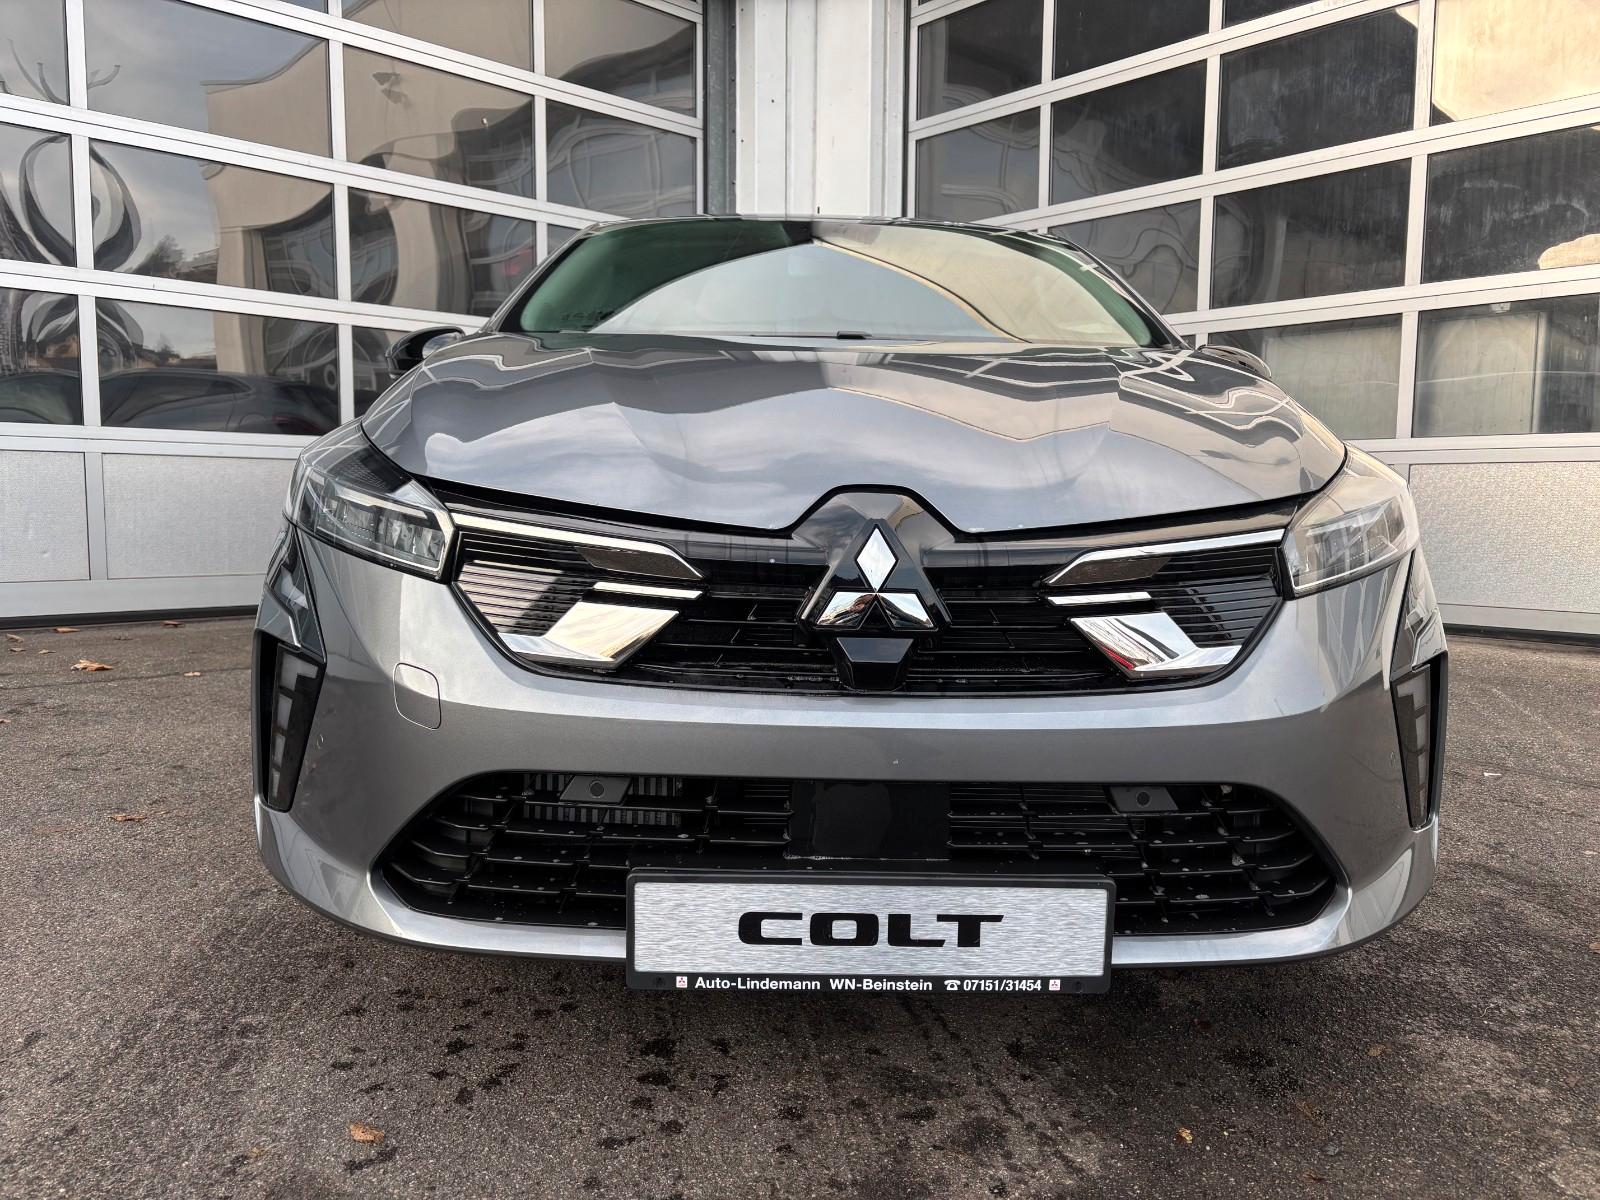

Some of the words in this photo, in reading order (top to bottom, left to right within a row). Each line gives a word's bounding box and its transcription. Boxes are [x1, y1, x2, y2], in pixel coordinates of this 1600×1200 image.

[738, 911, 1004, 948] COLT
[694, 977, 821, 990] Auto-Lindemann
[829, 979, 933, 991] WN-Beinstein
[963, 979, 1042, 991] 07151/31454
